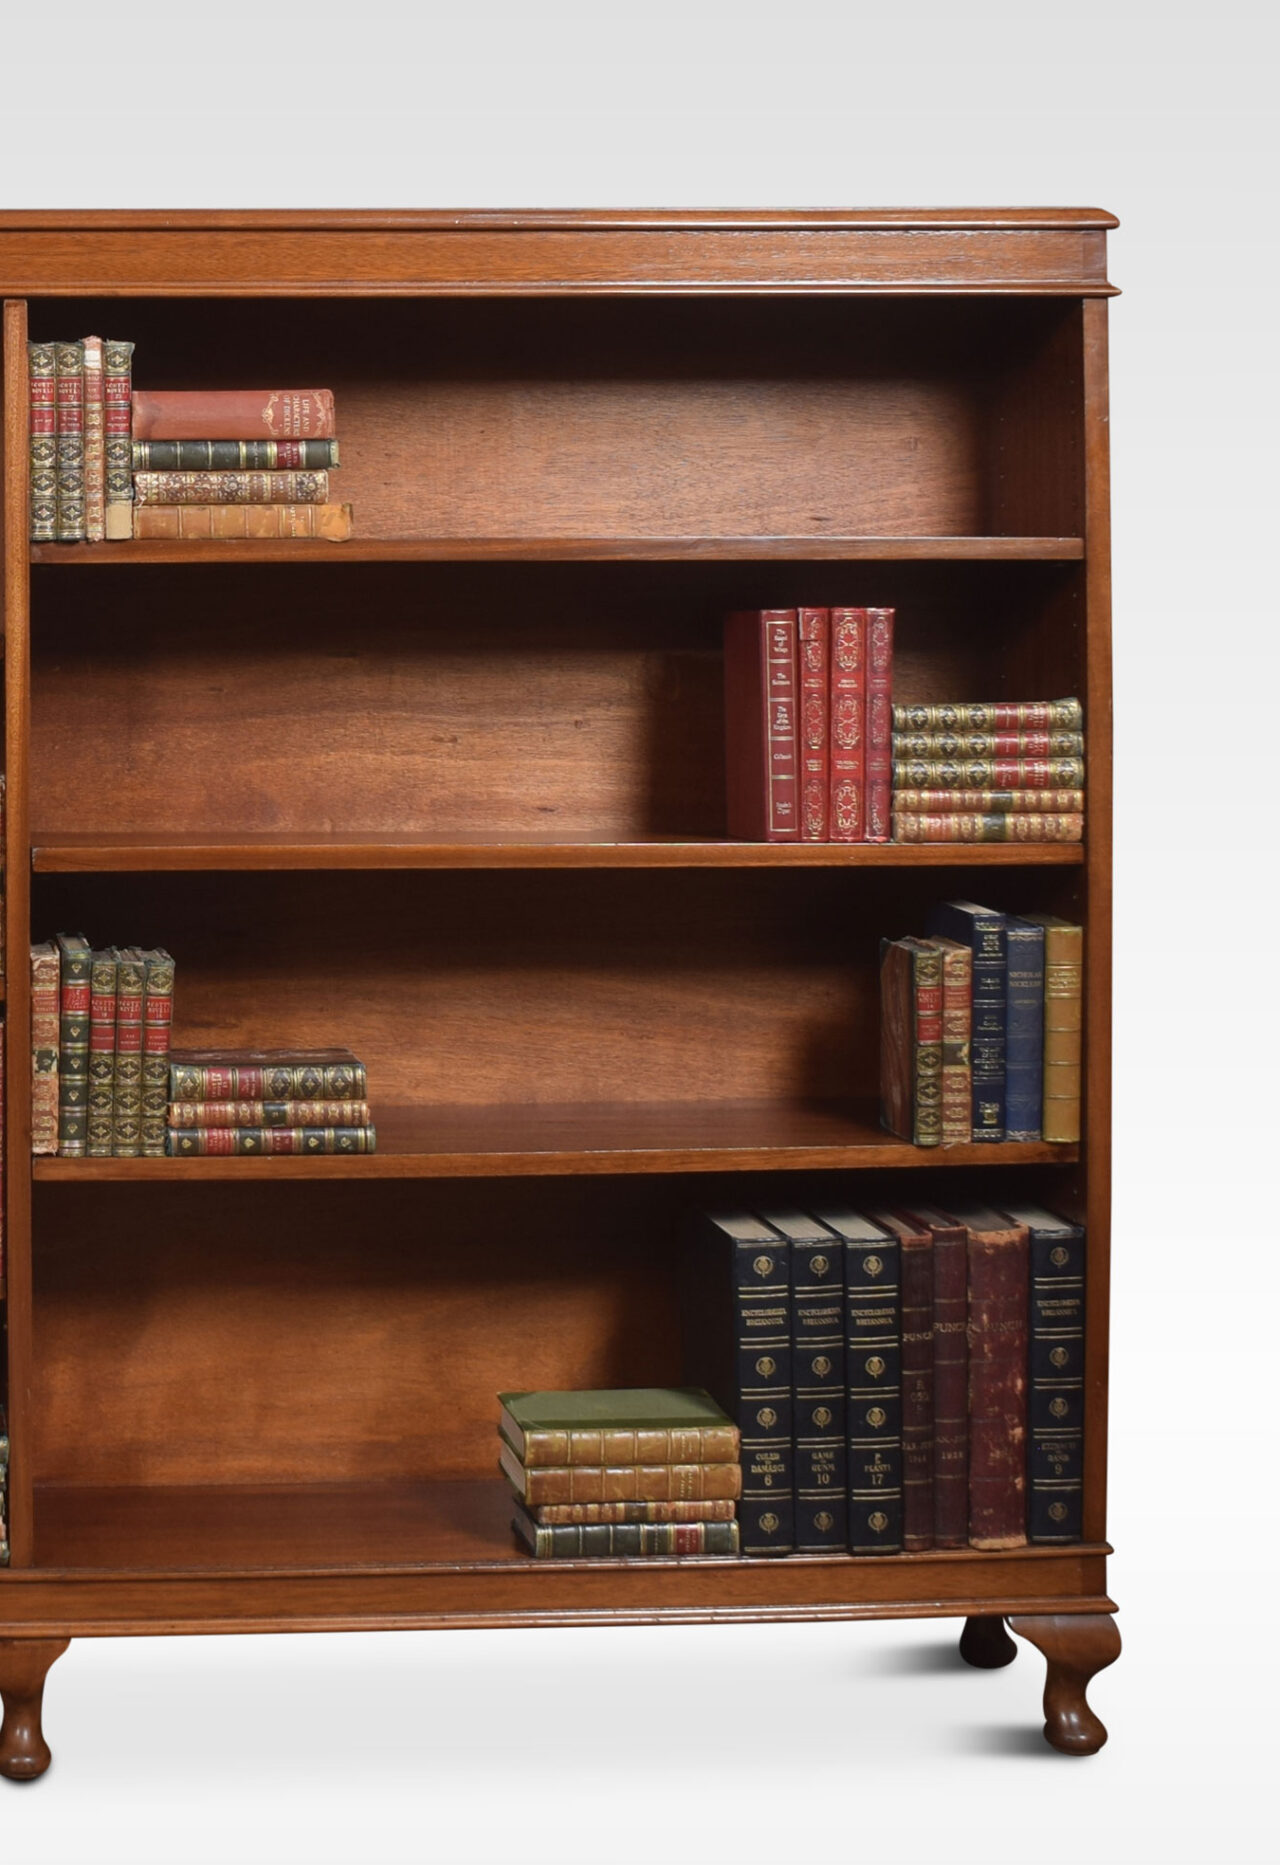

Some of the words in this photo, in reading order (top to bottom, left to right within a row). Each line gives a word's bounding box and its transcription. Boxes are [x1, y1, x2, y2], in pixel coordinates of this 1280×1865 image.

[302, 399, 310, 415] LIFE
[302, 416, 310, 432] AND
[1055, 1463, 1063, 1475] 9
[764, 1474, 773, 1486] 6
[816, 1473, 830, 1484] 10
[871, 1474, 884, 1486] 17
